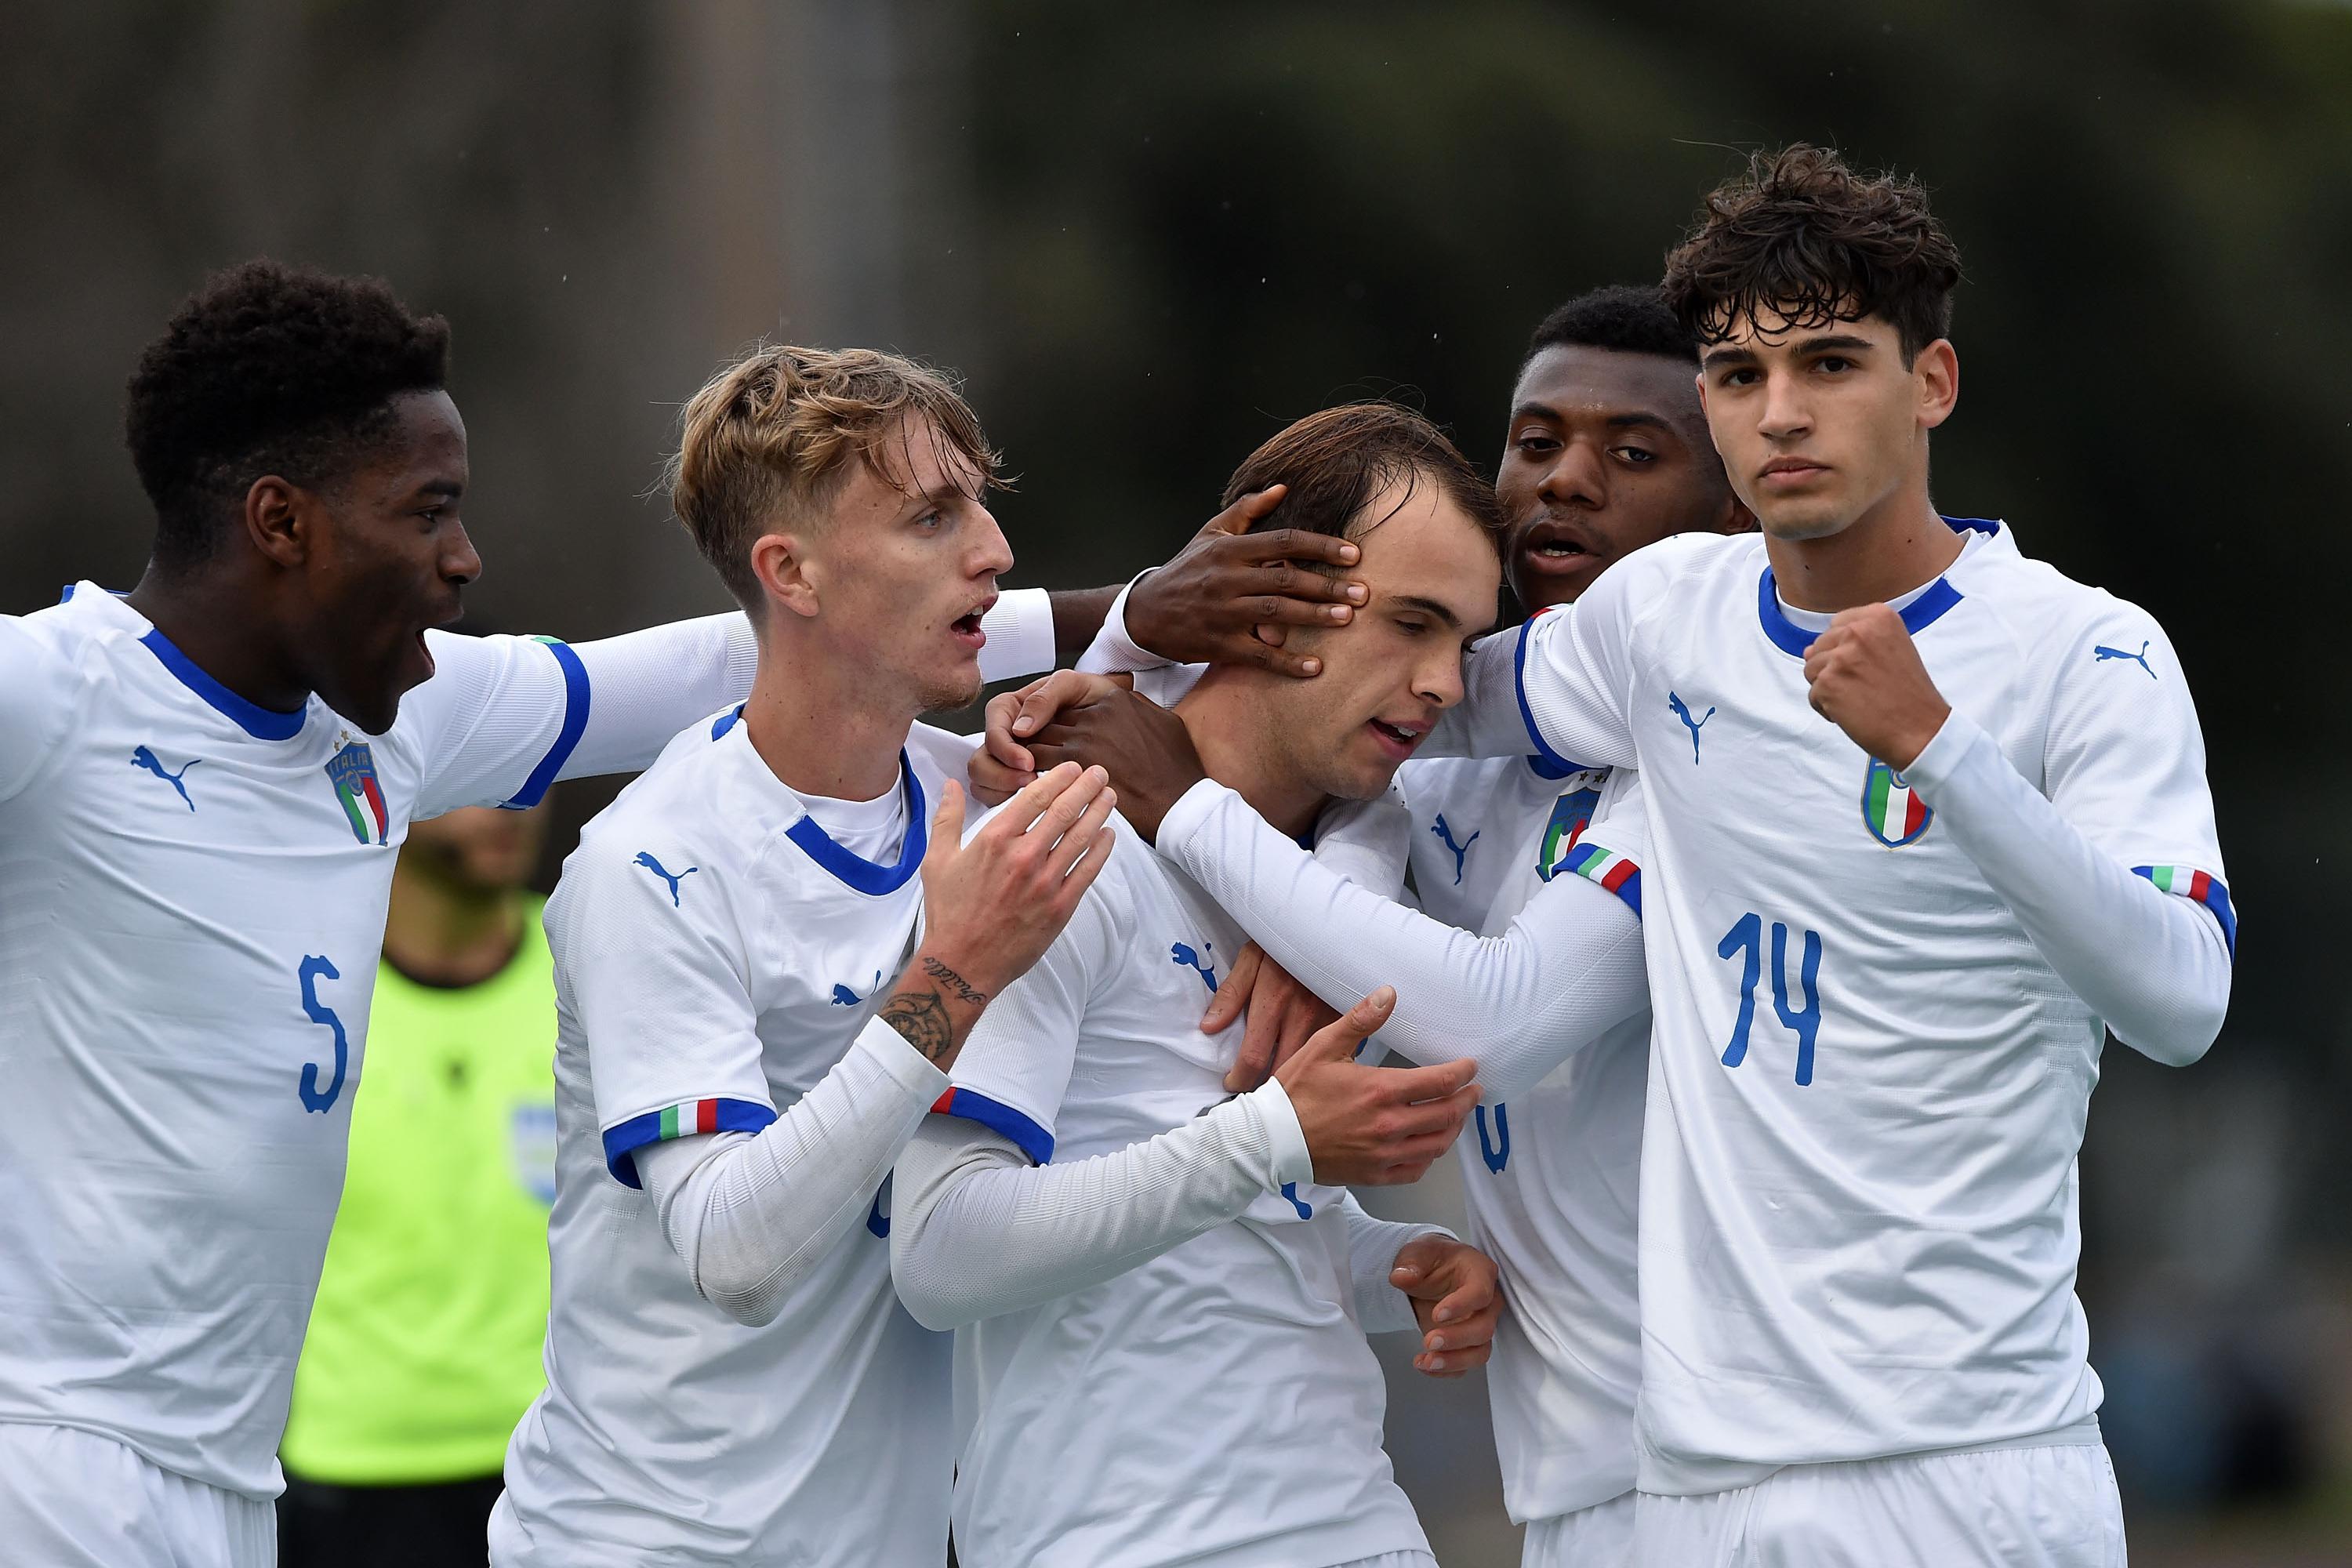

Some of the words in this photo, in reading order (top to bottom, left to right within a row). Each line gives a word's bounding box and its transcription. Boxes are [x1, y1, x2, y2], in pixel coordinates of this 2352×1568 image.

[329, 752, 369, 775] ITALIA
[923, 957, 987, 1005] Fratello
[1718, 912, 1822, 1086] 14
[299, 954, 347, 1113] 5
